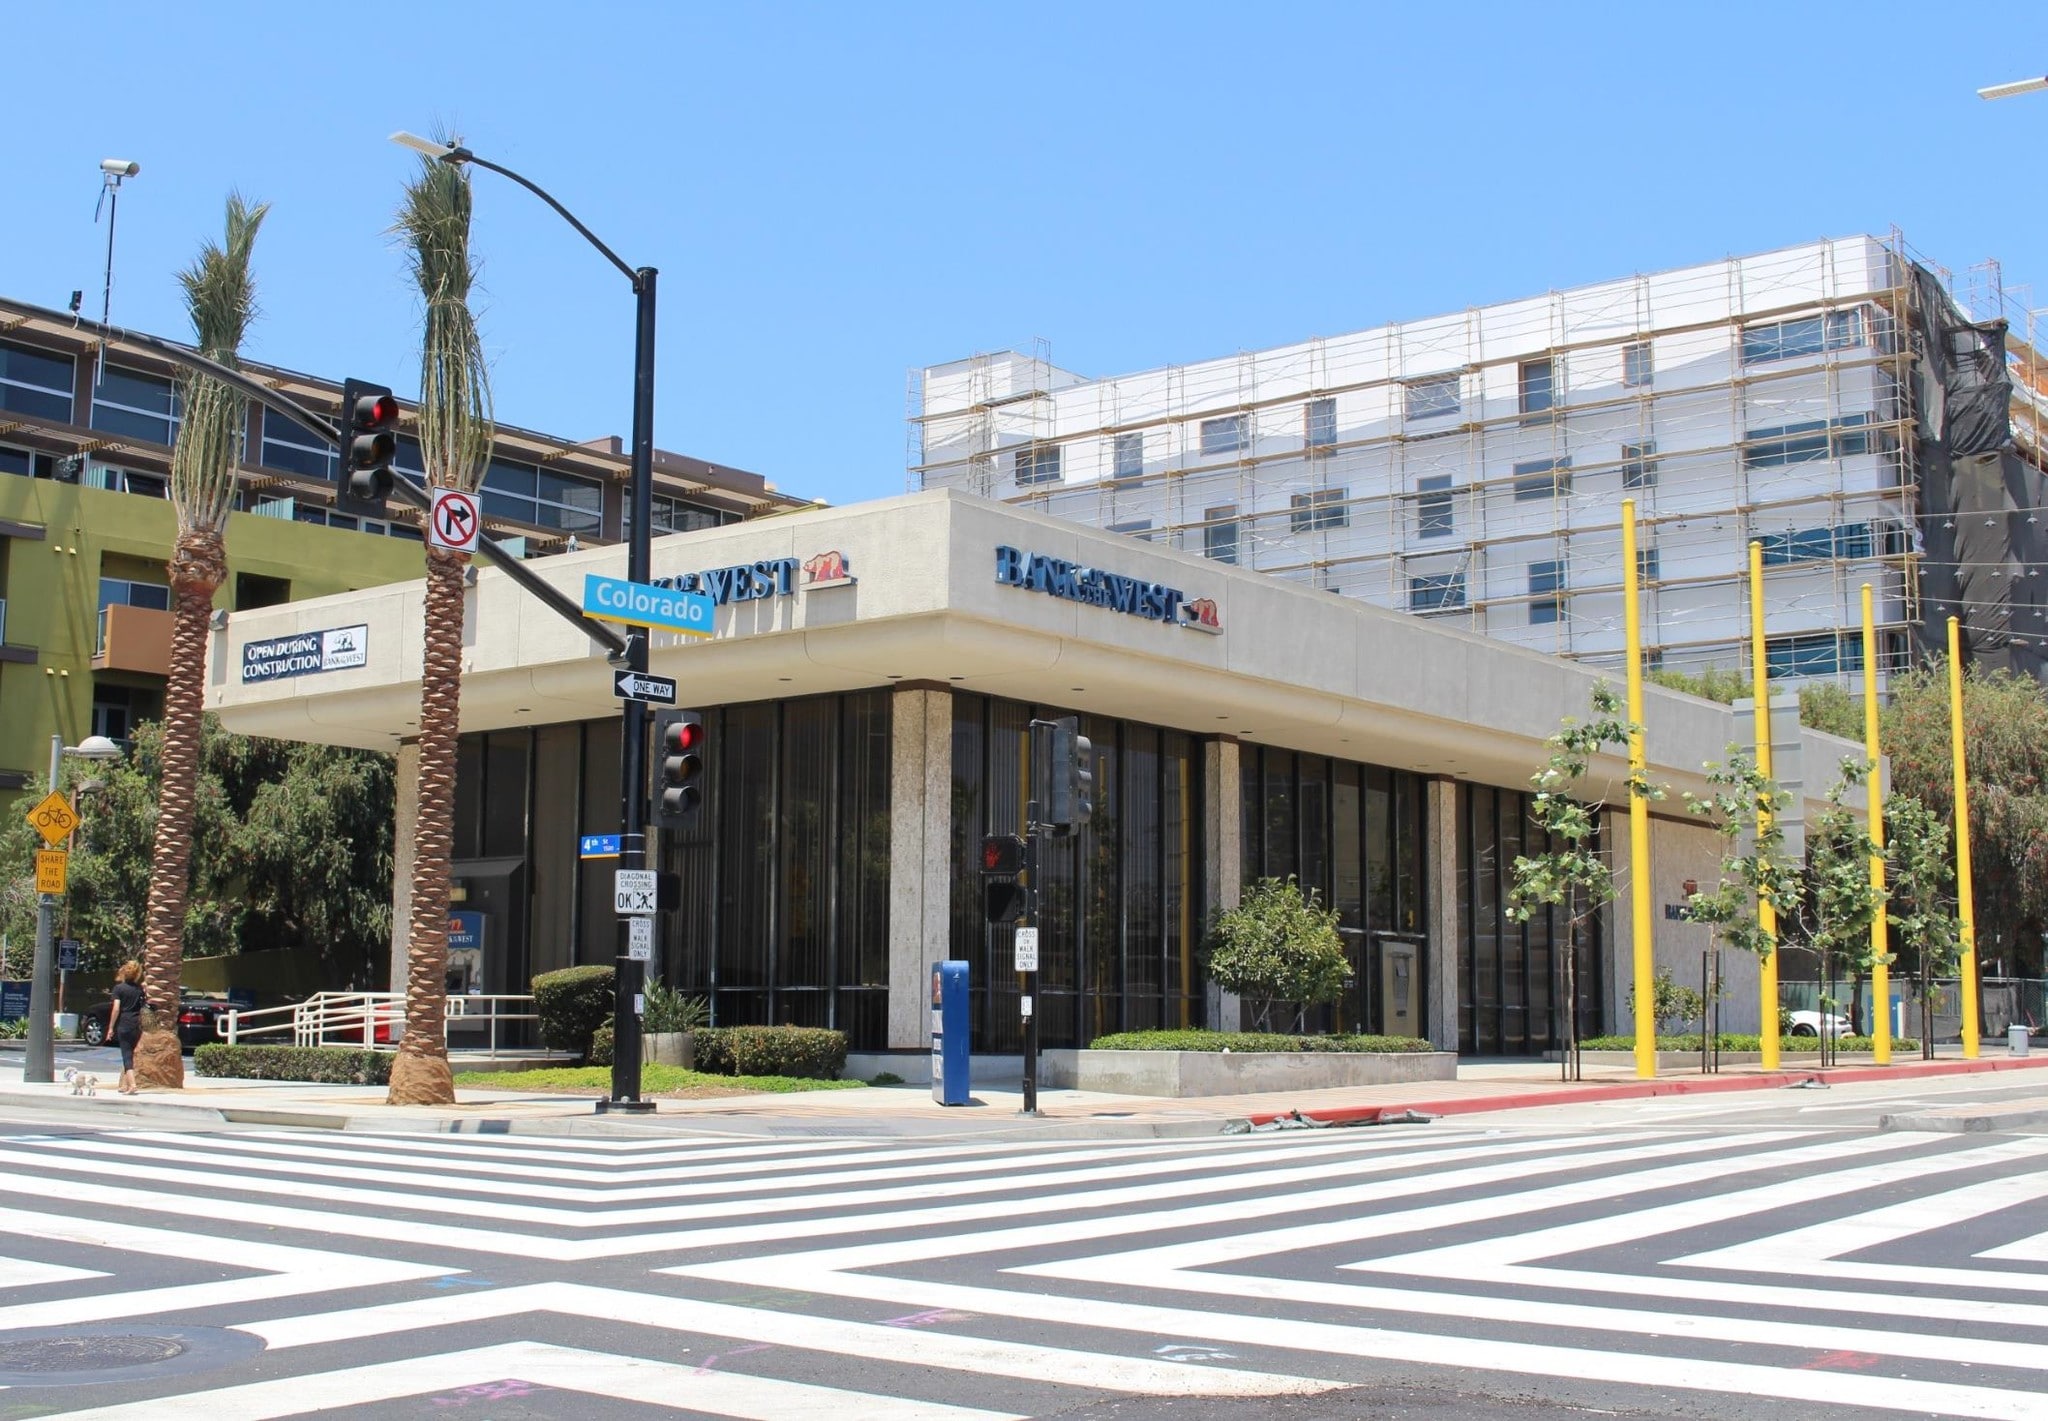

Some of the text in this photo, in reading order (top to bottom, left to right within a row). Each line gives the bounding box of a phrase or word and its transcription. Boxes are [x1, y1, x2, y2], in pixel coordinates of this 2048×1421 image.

[699, 557, 799, 606] WEST
[995, 545, 1184, 624] BANK OF WEST
[596, 581, 702, 622] Colorado
[248, 637, 317, 660] OPEN DURING
[243, 654, 321, 678] CONSTRUCTION
[633, 680, 670, 696] ONE WAY
[583, 838, 599, 851] 4th
[40, 855, 65, 865] SHARE
[44, 867, 59, 877] THE
[620, 872, 652, 880] DIAGONAL
[40, 879, 61, 889] ROAD
[620, 881, 653, 889] CROSSING
[617, 892, 632, 909] OK
[631, 920, 650, 928] CROSS
[1017, 930, 1036, 938] CROSS
[632, 950, 647, 958] ONLY
[1016, 952, 1036, 961] SIGNAL
[1019, 961, 1034, 969] ONLY
